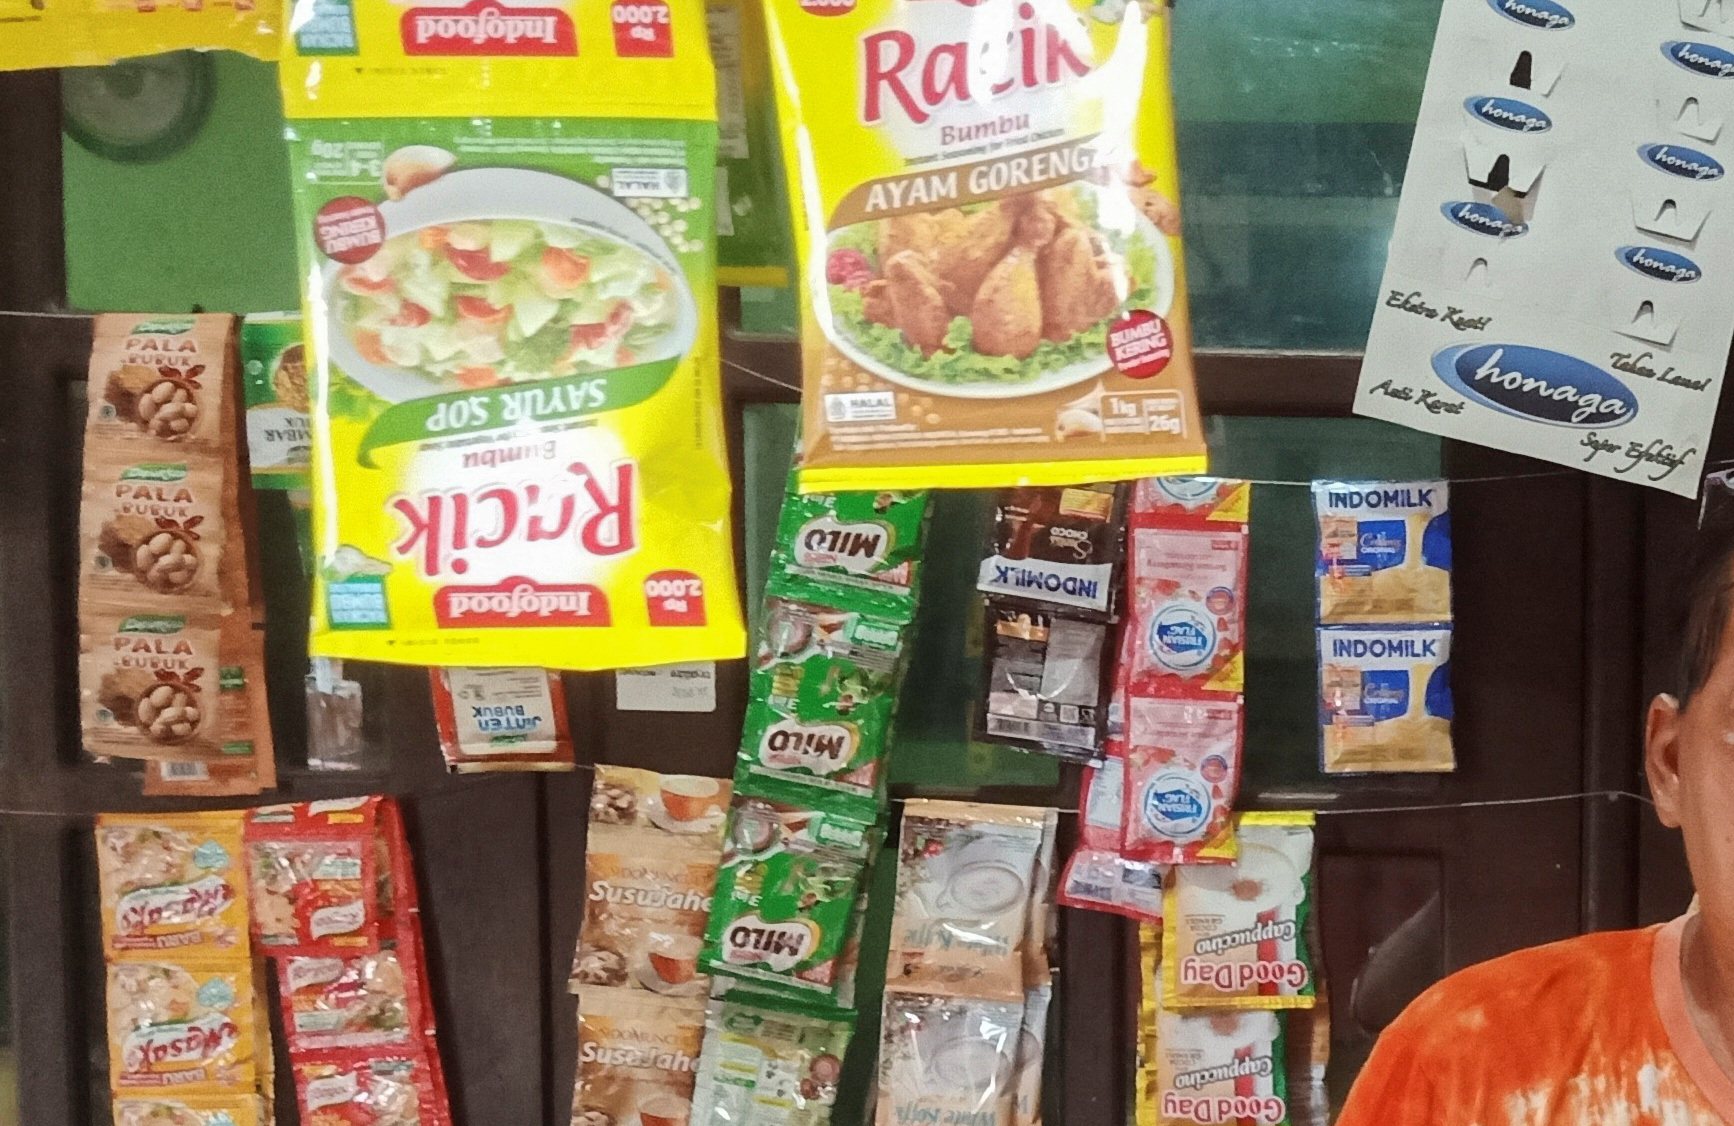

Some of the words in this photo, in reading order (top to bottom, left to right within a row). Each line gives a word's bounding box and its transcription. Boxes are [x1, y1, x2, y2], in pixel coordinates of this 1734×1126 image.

[416, 9, 557, 44] Indofood
[611, 4, 670, 23] 2.000
[630, 25, 655, 41] Rp
[940, 113, 1030, 145] Bumbu
[1481, 99, 1547, 132] honaga
[1654, 147, 1719, 179] honaga
[864, 171, 959, 213] AYAM
[968, 147, 1092, 195] GORENG
[1632, 248, 1697, 281] honaga
[126, 338, 196, 353] PALA
[1475, 348, 1627, 423] honaga
[424, 395, 489, 433] SOP
[500, 379, 607, 424] SAYUR
[461, 440, 557, 469] Bumbu
[116, 484, 192, 503] PALA
[1329, 488, 1433, 508] INDOMILK
[804, 529, 881, 558] MILO
[645, 579, 702, 598] 2.000
[990, 565, 1097, 599] INDOMILK
[447, 585, 590, 618] Indofood
[662, 598, 687, 613] Rp
[114, 637, 193, 655] PALA
[1333, 638, 1436, 658] INDOMILK
[472, 705, 523, 718] BUBUK
[767, 731, 844, 760] MILO
[729, 926, 805, 957] MILO
[1194, 920, 1296, 955] Cappuccino
[1183, 957, 1233, 989] Day
[1240, 962, 1306, 988] Good
[1173, 1056, 1272, 1090] Cappuccino
[1164, 1092, 1212, 1123] Day
[1218, 1098, 1282, 1122] Good
